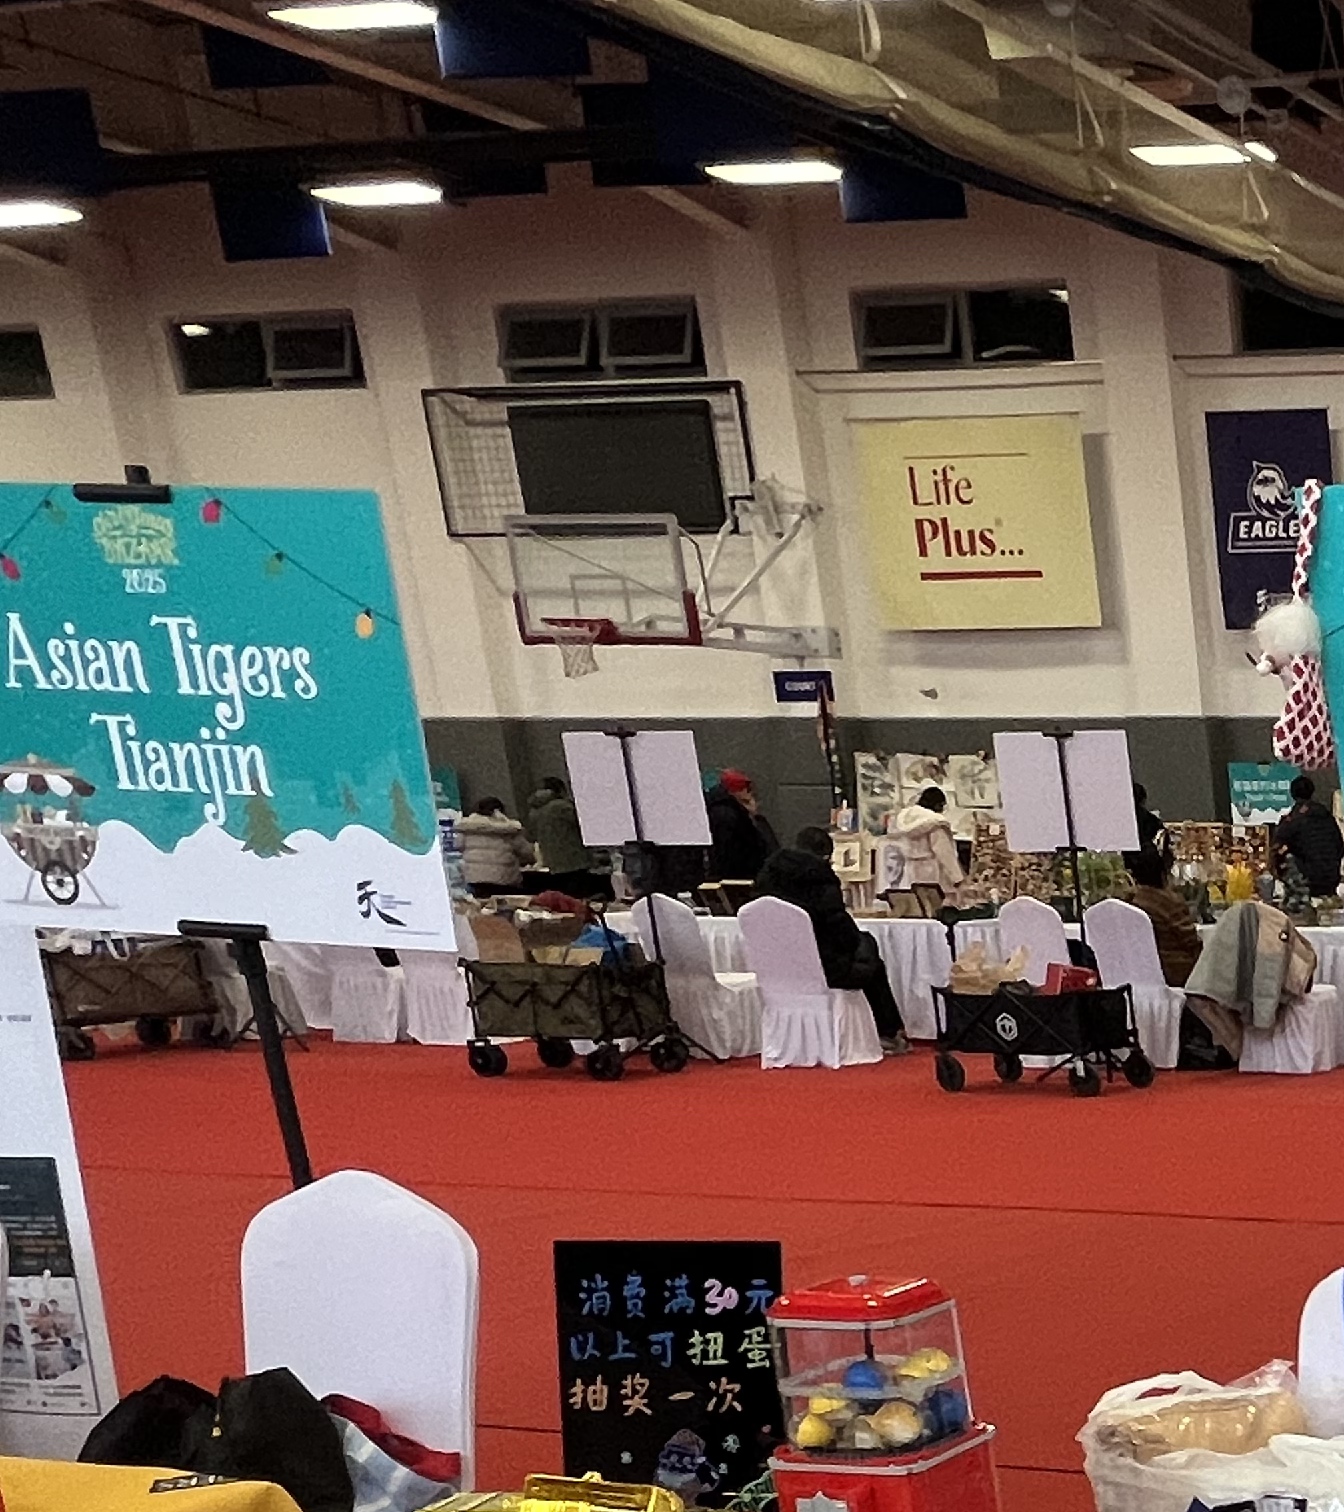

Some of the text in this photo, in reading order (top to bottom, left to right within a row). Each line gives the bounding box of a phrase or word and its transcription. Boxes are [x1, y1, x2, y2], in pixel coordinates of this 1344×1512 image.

[908, 464, 975, 507] Life
[914, 516, 1025, 559] Plus...
[121, 568, 167, 594] 2025
[4, 612, 319, 731] Asian Tigers
[89, 713, 275, 826] Tianjin
[568, 1328, 778, 1370] 以上可扭蛋
[568, 1371, 744, 1418] 抽奖一次
